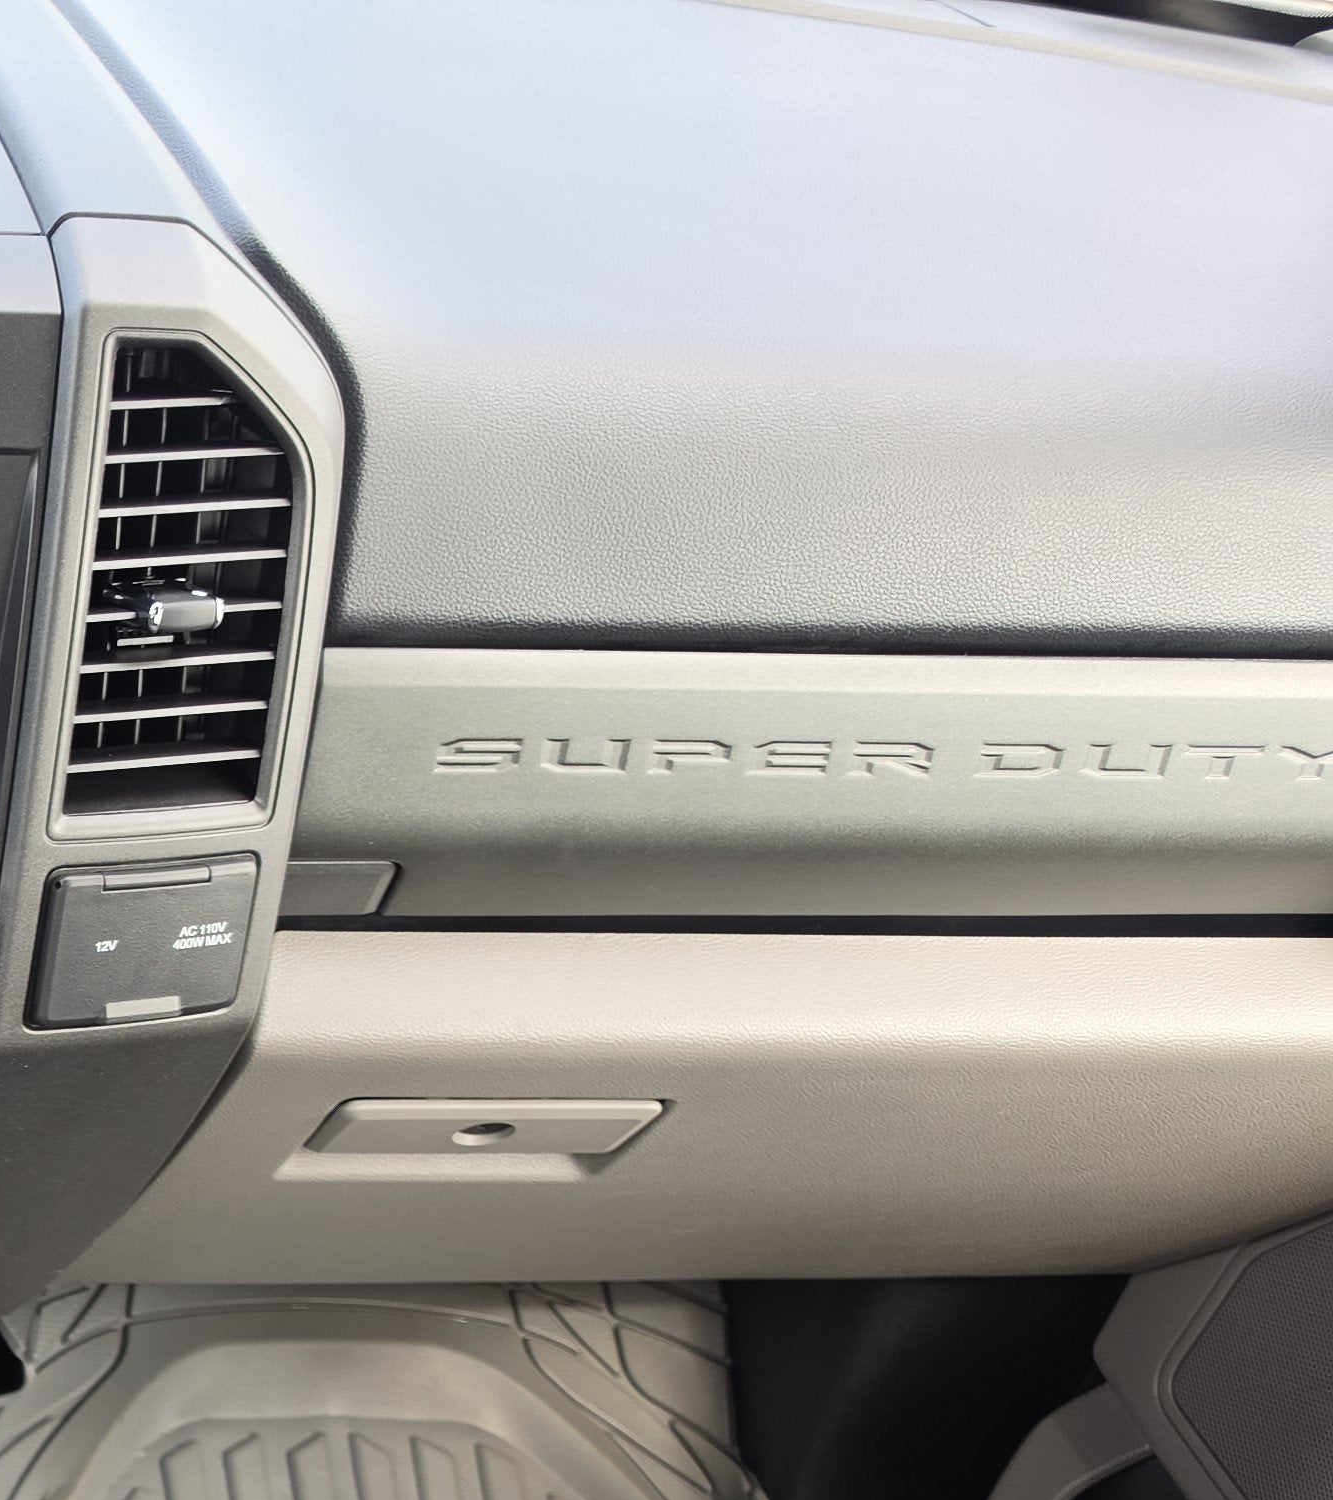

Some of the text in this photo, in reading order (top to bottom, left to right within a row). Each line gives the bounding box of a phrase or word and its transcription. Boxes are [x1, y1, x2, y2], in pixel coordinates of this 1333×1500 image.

[433, 738, 935, 776] SUPER
[179, 922, 228, 938] AC 110V
[95, 939, 120, 953] 12V
[172, 933, 232, 950] 400W MAX
